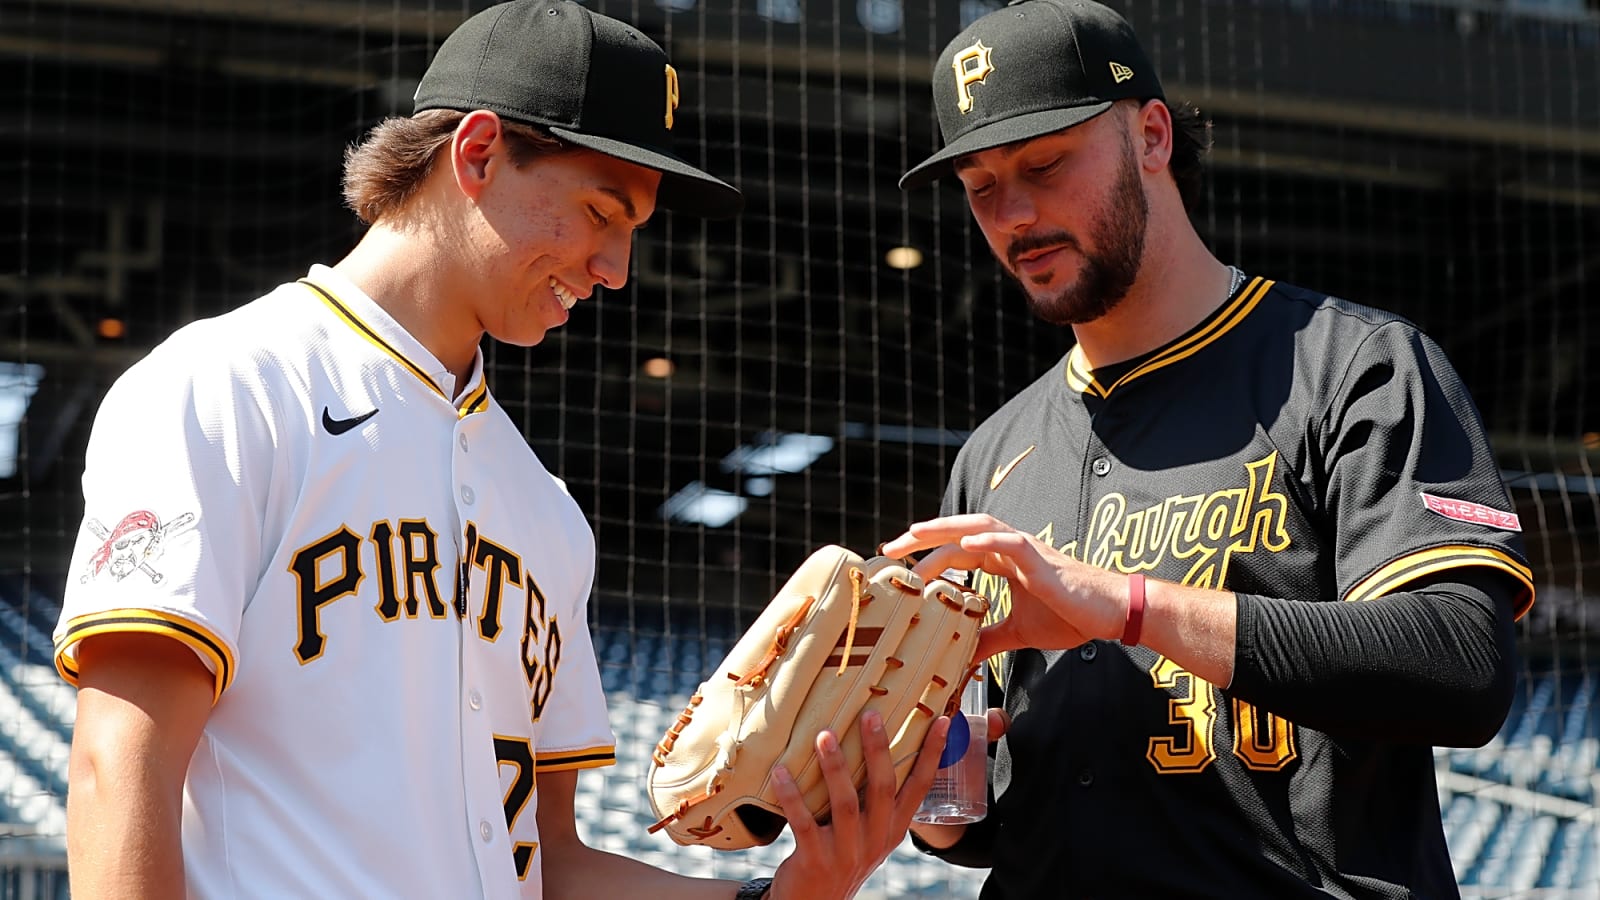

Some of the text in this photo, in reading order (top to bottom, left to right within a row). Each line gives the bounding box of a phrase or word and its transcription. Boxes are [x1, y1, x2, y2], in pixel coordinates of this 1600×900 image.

[664, 63, 679, 130] P
[952, 39, 996, 115] P
[1428, 497, 1515, 526] SHEETZ
